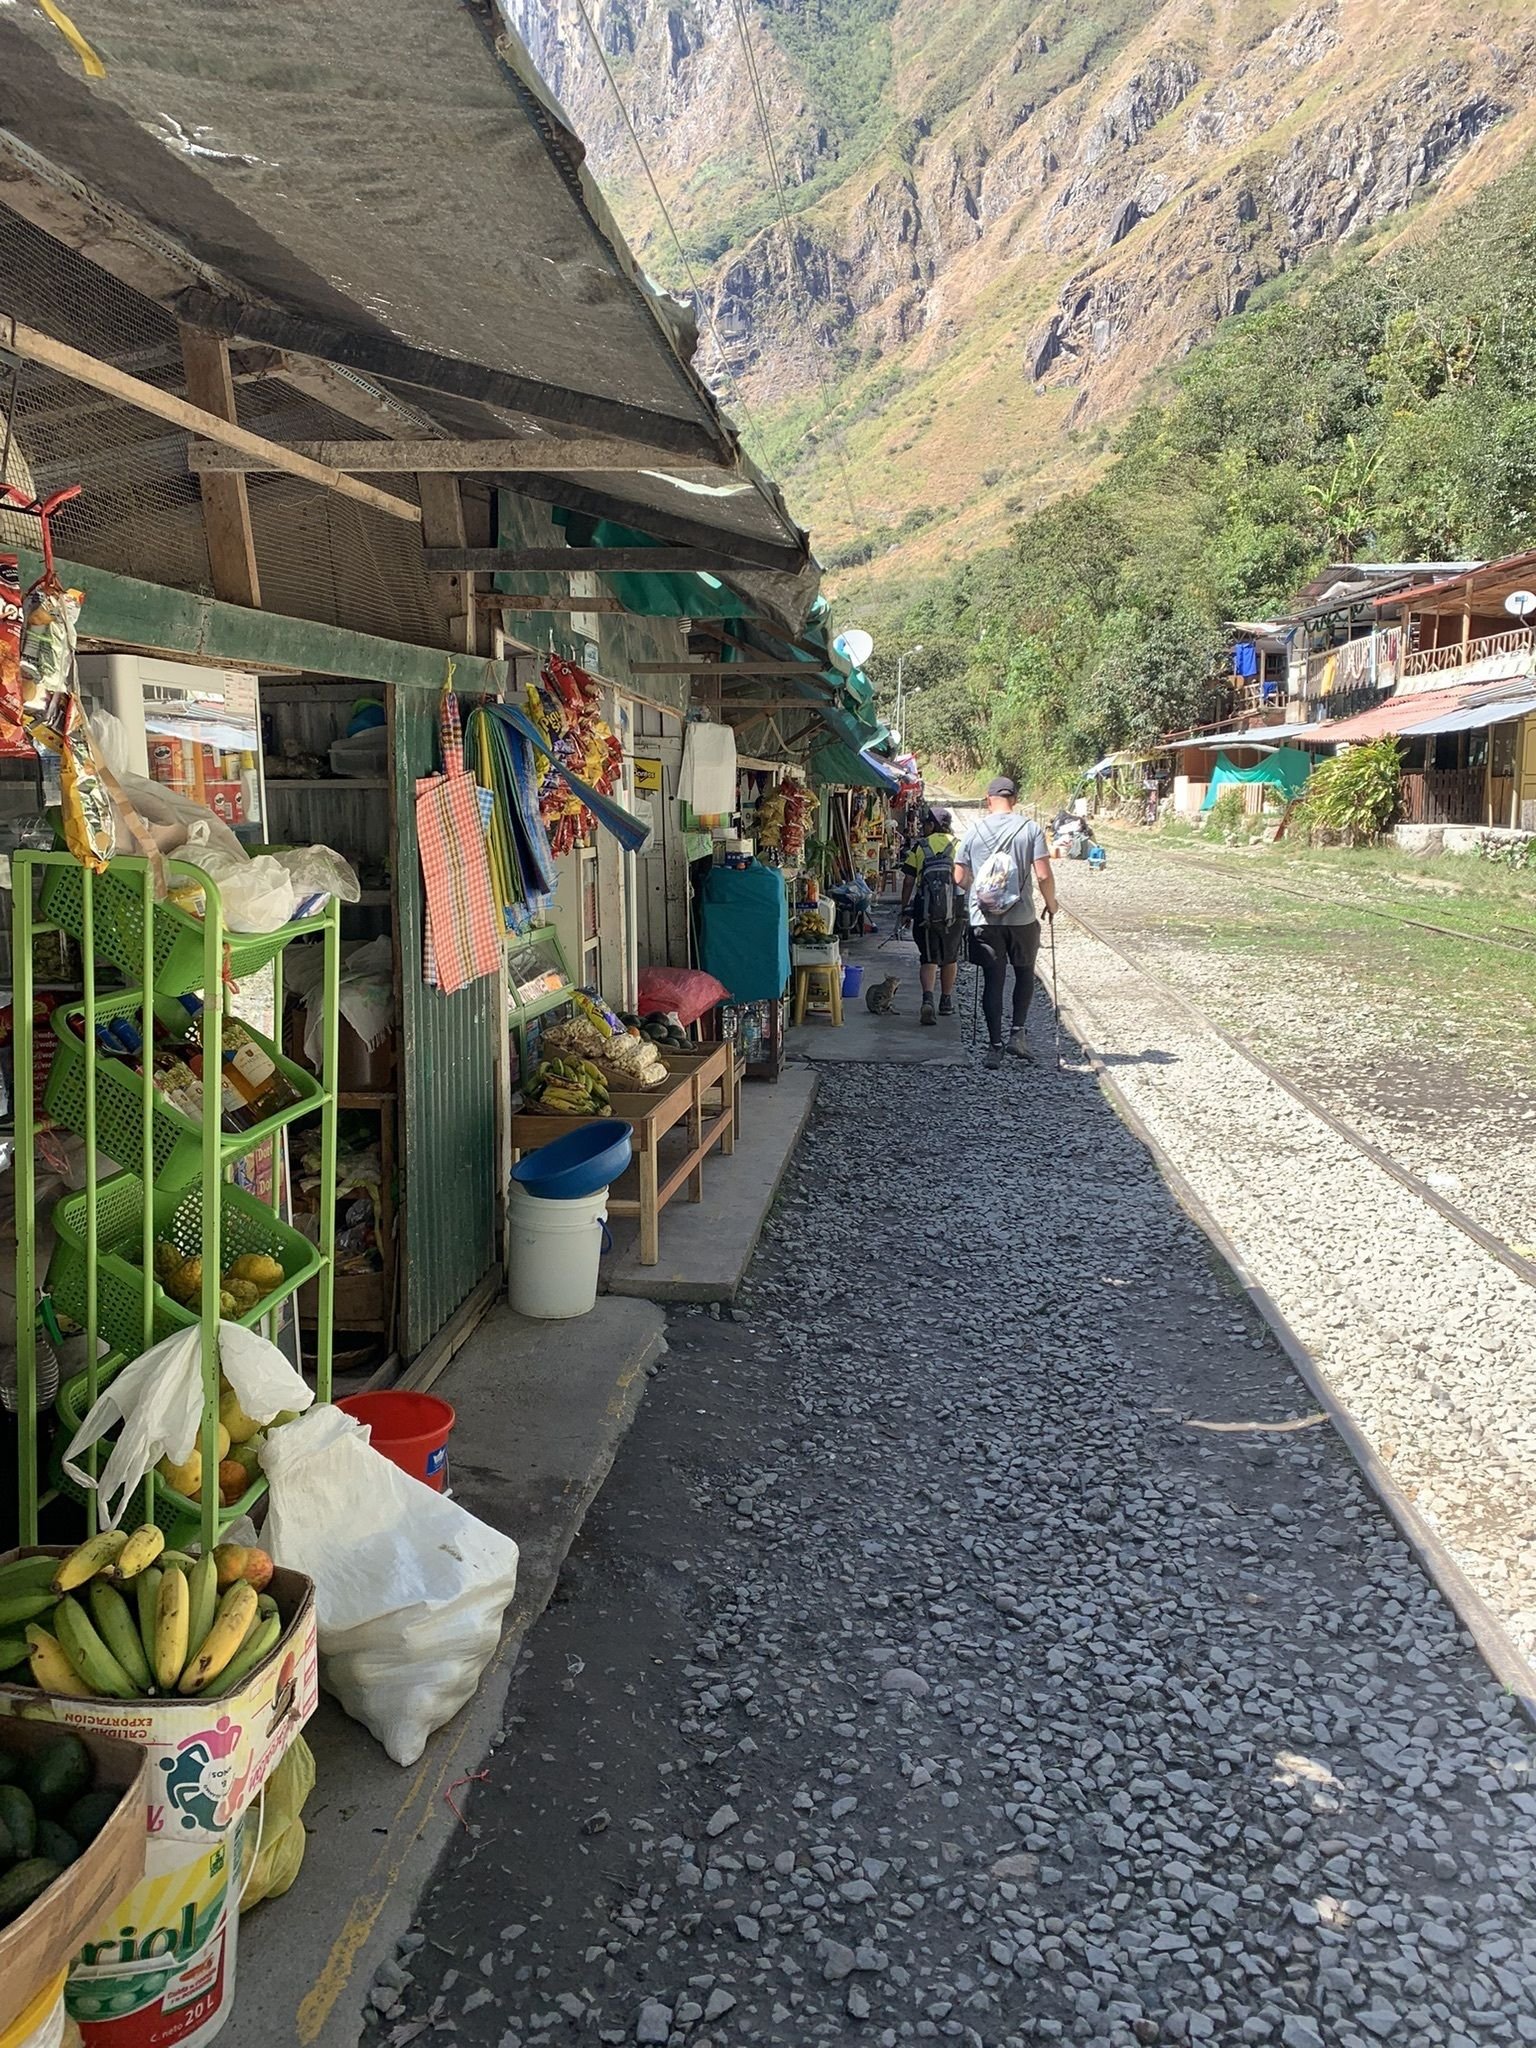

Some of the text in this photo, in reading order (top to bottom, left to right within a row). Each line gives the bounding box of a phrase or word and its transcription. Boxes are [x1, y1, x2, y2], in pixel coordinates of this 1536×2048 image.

[540, 711, 561, 733] Piqu
[81, 1902, 198, 1966] riol
[162, 2022, 184, 2040] neto
[184, 2005, 204, 2026] 20
[206, 1994, 214, 2010] L
